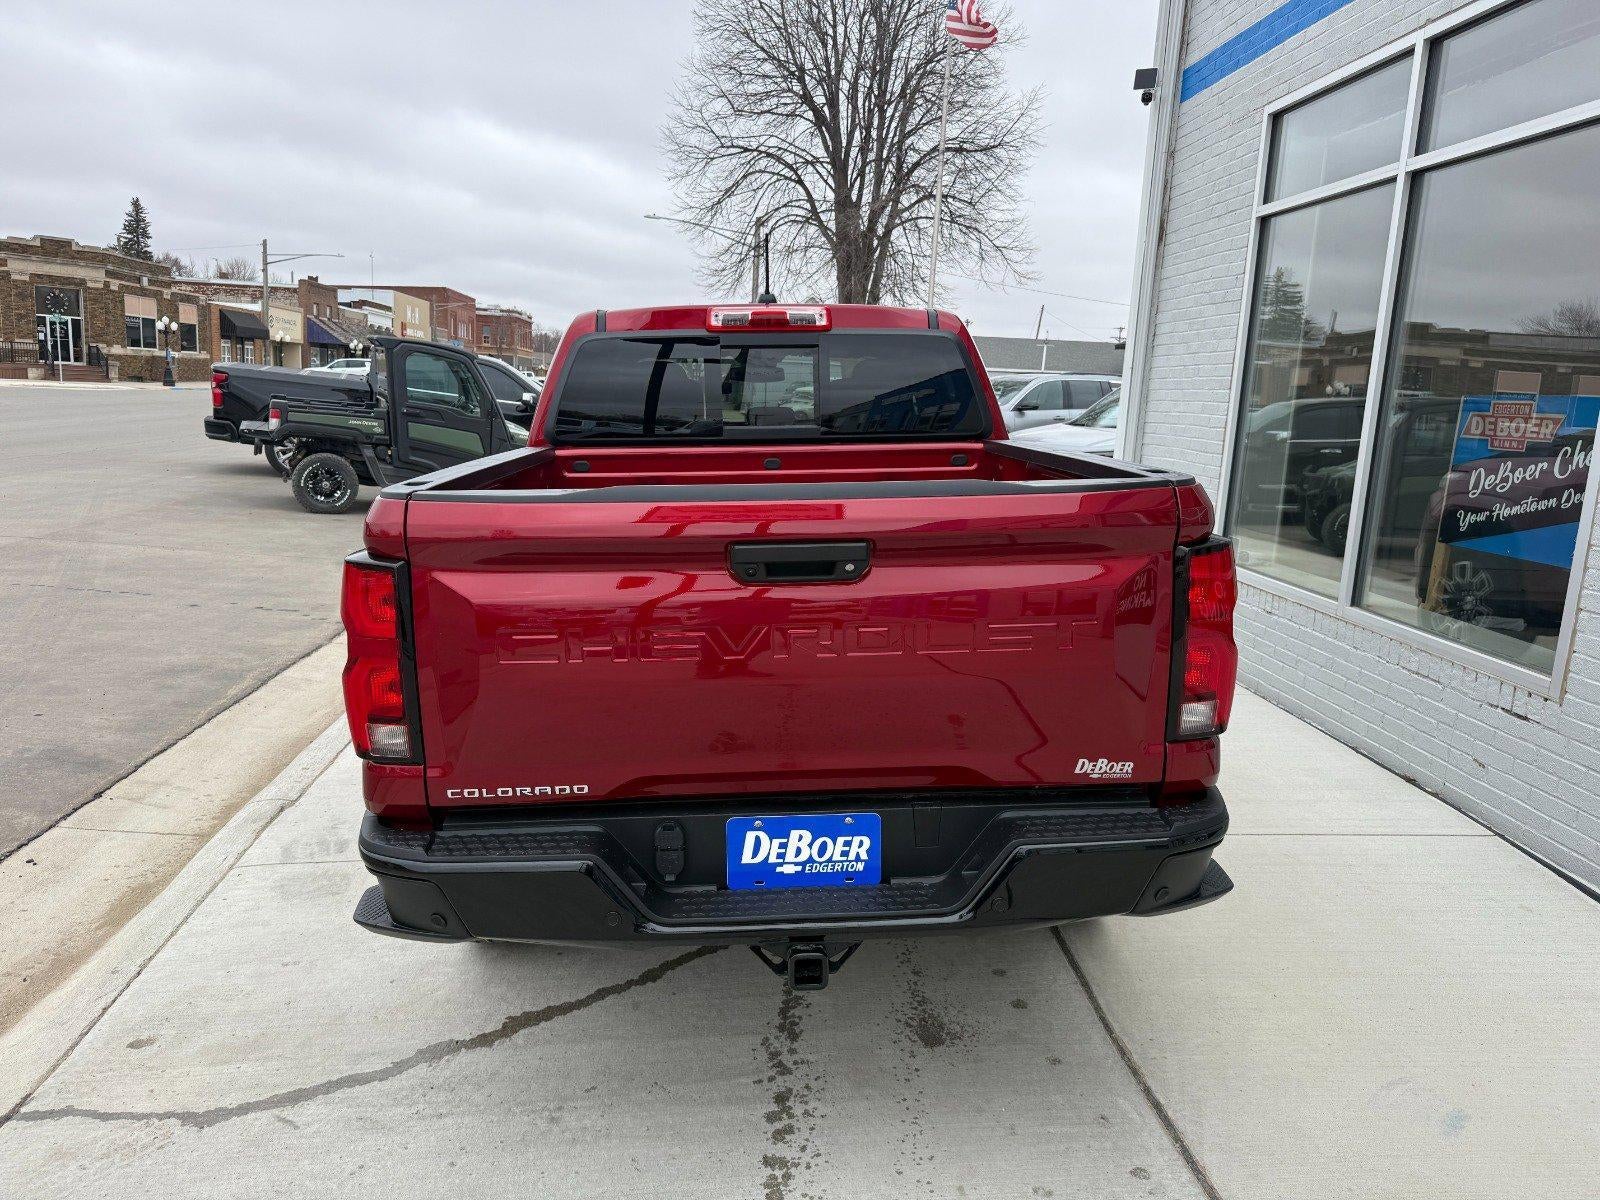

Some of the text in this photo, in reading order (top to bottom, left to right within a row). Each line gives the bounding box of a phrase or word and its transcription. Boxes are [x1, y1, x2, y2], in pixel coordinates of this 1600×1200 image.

[1493, 403, 1531, 416] EDGERTON
[1470, 416, 1554, 438] DEBOER
[1468, 460, 1548, 498] DeBoer
[1456, 509, 1490, 532] Your
[1492, 495, 1558, 522] Hometown
[498, 616, 1100, 663] CHEVROLET
[446, 784, 589, 799] COLORADO
[804, 861, 865, 874] EDGERTON
